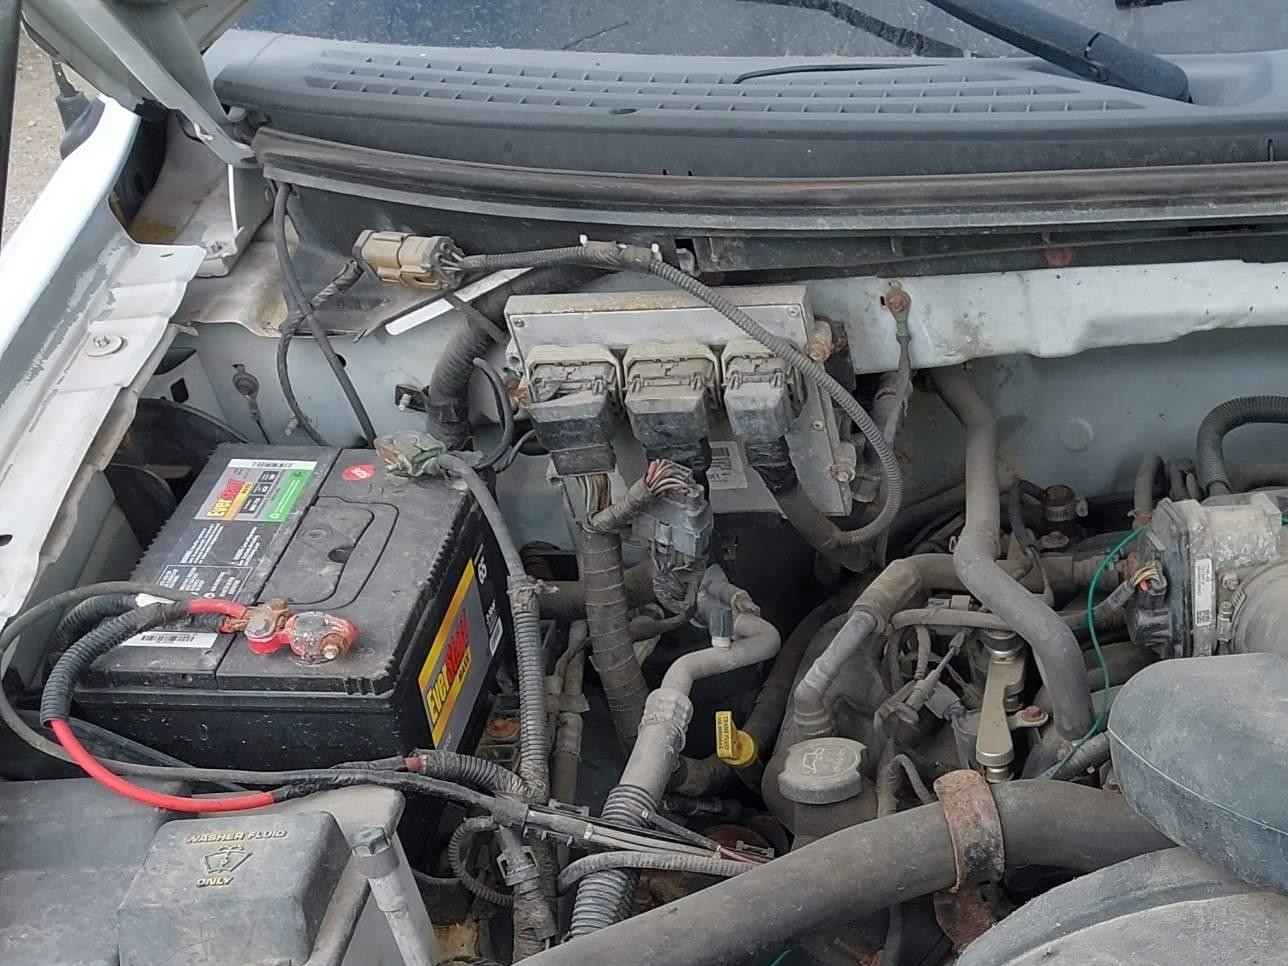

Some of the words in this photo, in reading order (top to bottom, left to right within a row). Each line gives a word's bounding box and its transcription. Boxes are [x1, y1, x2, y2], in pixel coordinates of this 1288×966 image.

[426, 612, 470, 727] EverStart
[186, 831, 246, 844] WASHER
[247, 829, 288, 840] FLUID
[196, 876, 235, 888] ONLY
